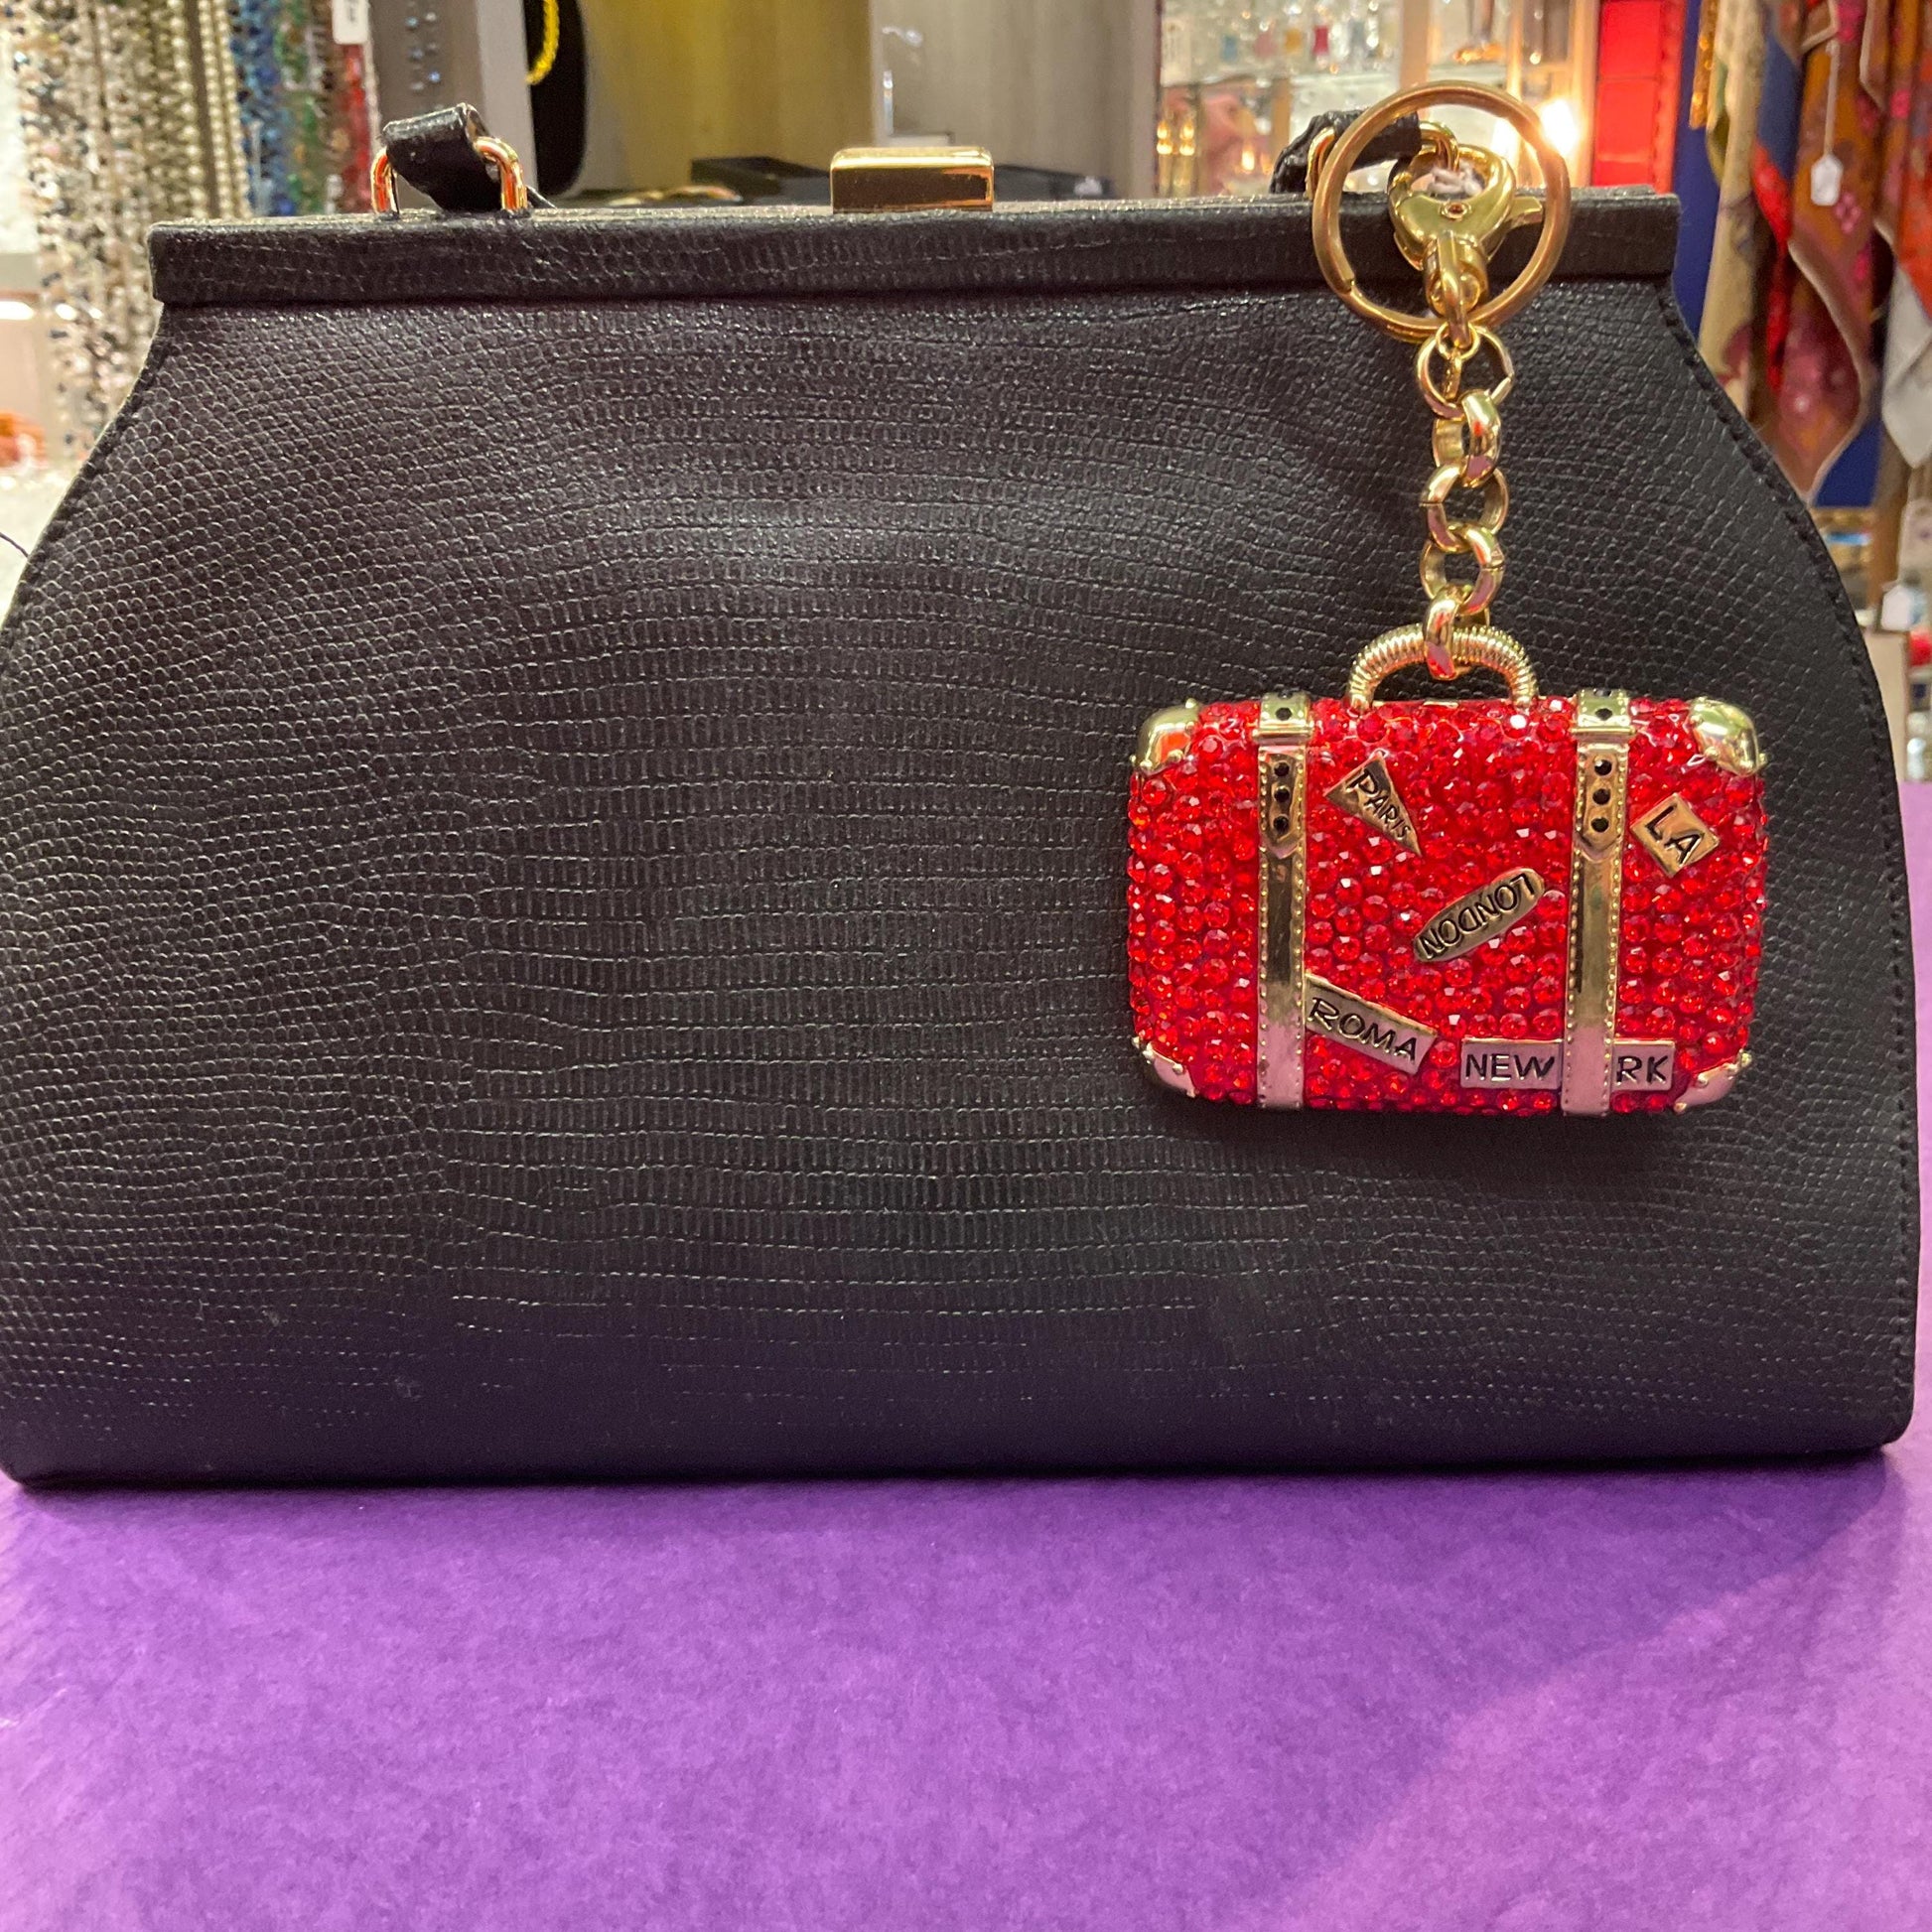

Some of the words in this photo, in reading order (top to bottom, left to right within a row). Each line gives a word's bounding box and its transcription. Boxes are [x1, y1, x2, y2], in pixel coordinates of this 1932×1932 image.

[1345, 767, 1411, 840] PARIS
[1644, 803, 1705, 867] LA
[1420, 873, 1536, 961] LONDON
[1308, 997, 1418, 1063] ROMA
[1465, 1053, 1555, 1081] NEW
[1616, 1055, 1669, 1084] RK
